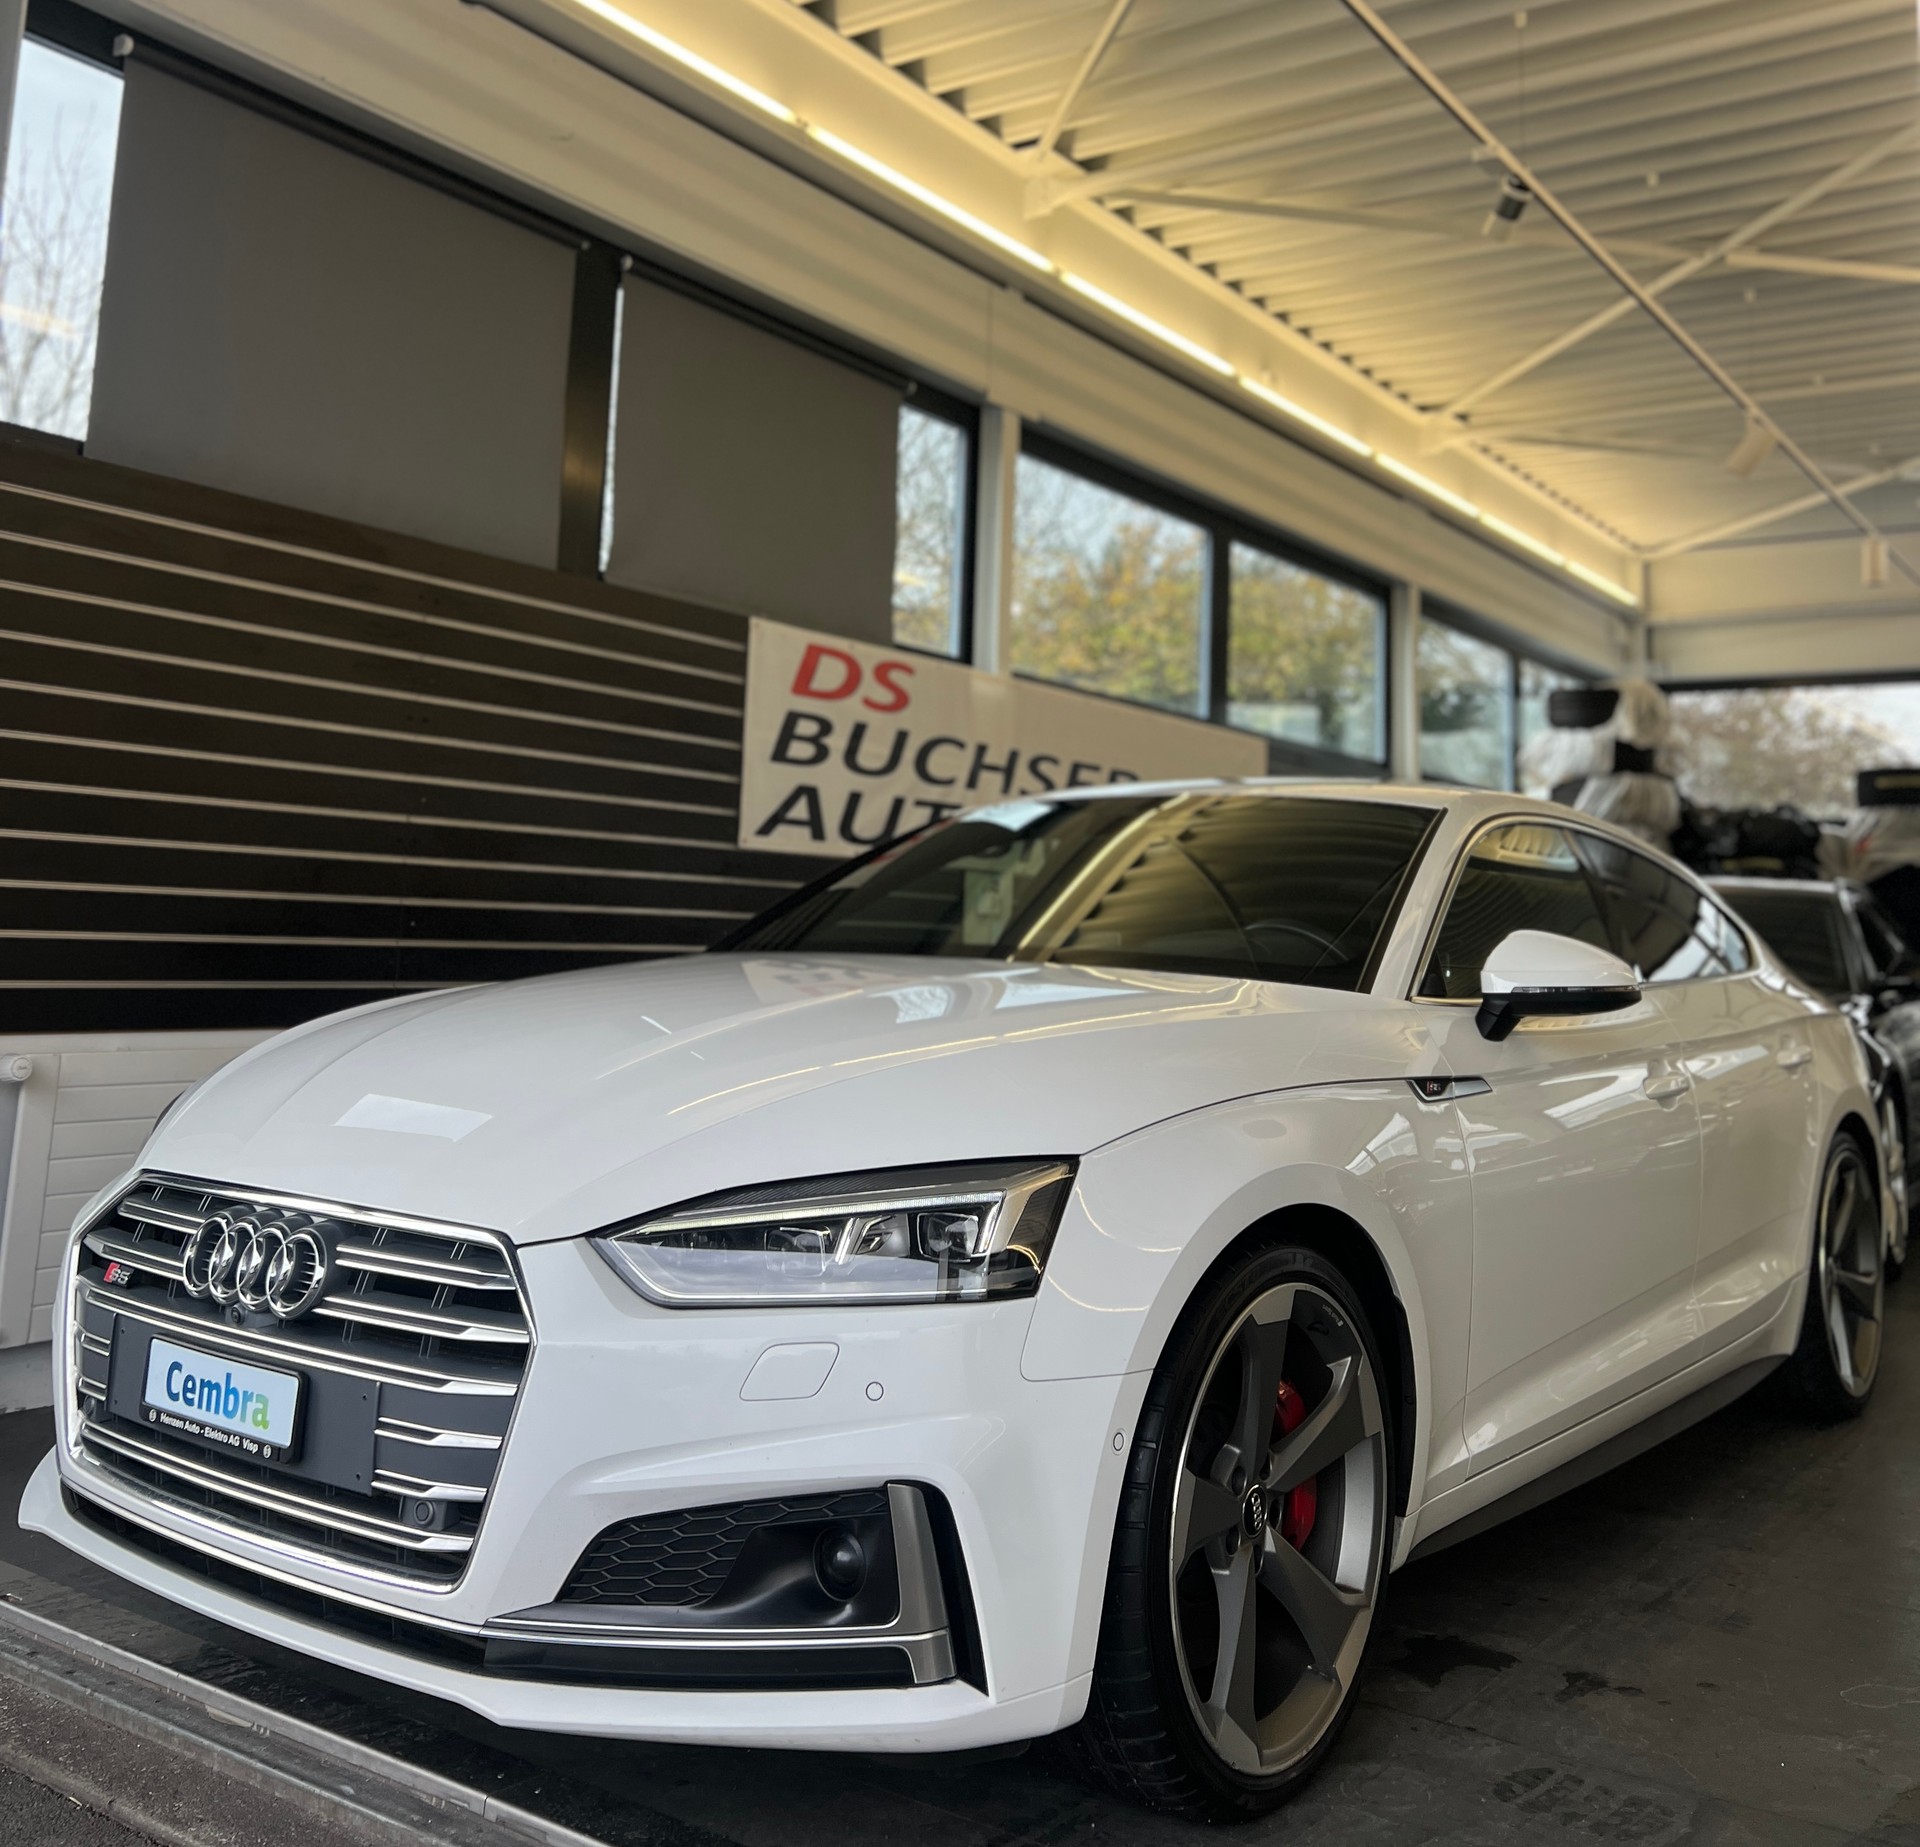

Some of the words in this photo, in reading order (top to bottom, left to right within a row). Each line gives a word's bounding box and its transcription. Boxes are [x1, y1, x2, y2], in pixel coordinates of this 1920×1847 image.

[790, 643, 916, 713] DS
[166, 1361, 270, 1431] Cembra
[160, 1412, 184, 1429] Henzen
[184, 1420, 201, 1435] Auto
[204, 1426, 228, 1443] Elektro
[228, 1434, 241, 1447] AG
[242, 1438, 259, 1455] Visp
